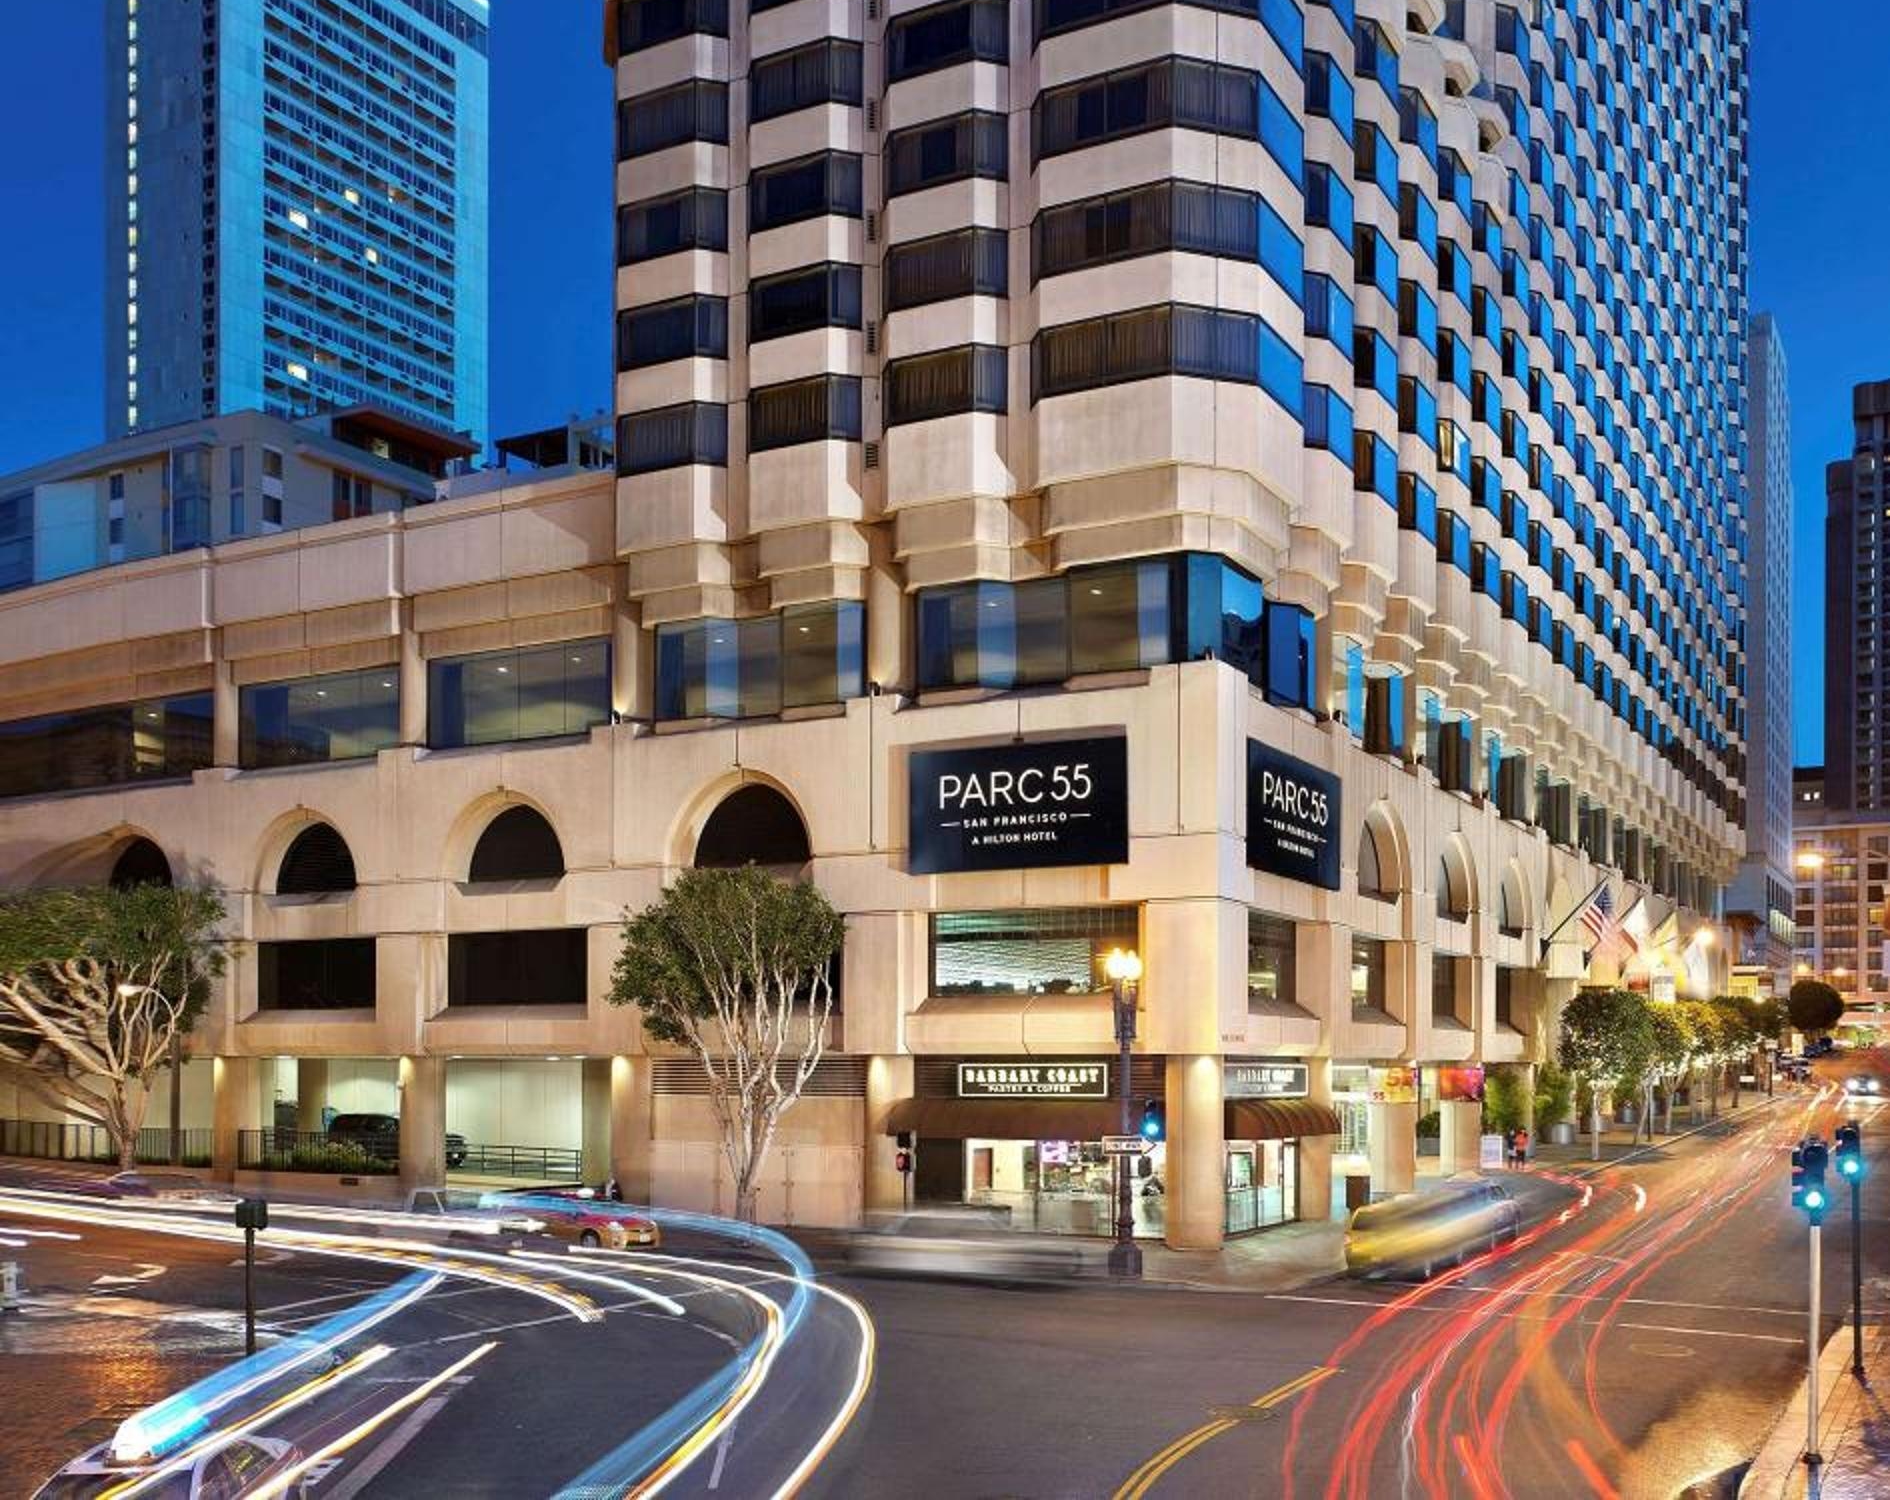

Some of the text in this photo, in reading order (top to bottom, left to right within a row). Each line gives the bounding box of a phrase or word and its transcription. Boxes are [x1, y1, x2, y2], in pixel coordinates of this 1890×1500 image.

[939, 763, 1092, 809] PARC 55
[1263, 771, 1328, 826] PARC 55
[963, 812, 1067, 829] SAN FRANCISCO
[971, 831, 1057, 845] A HILTON HOTEL
